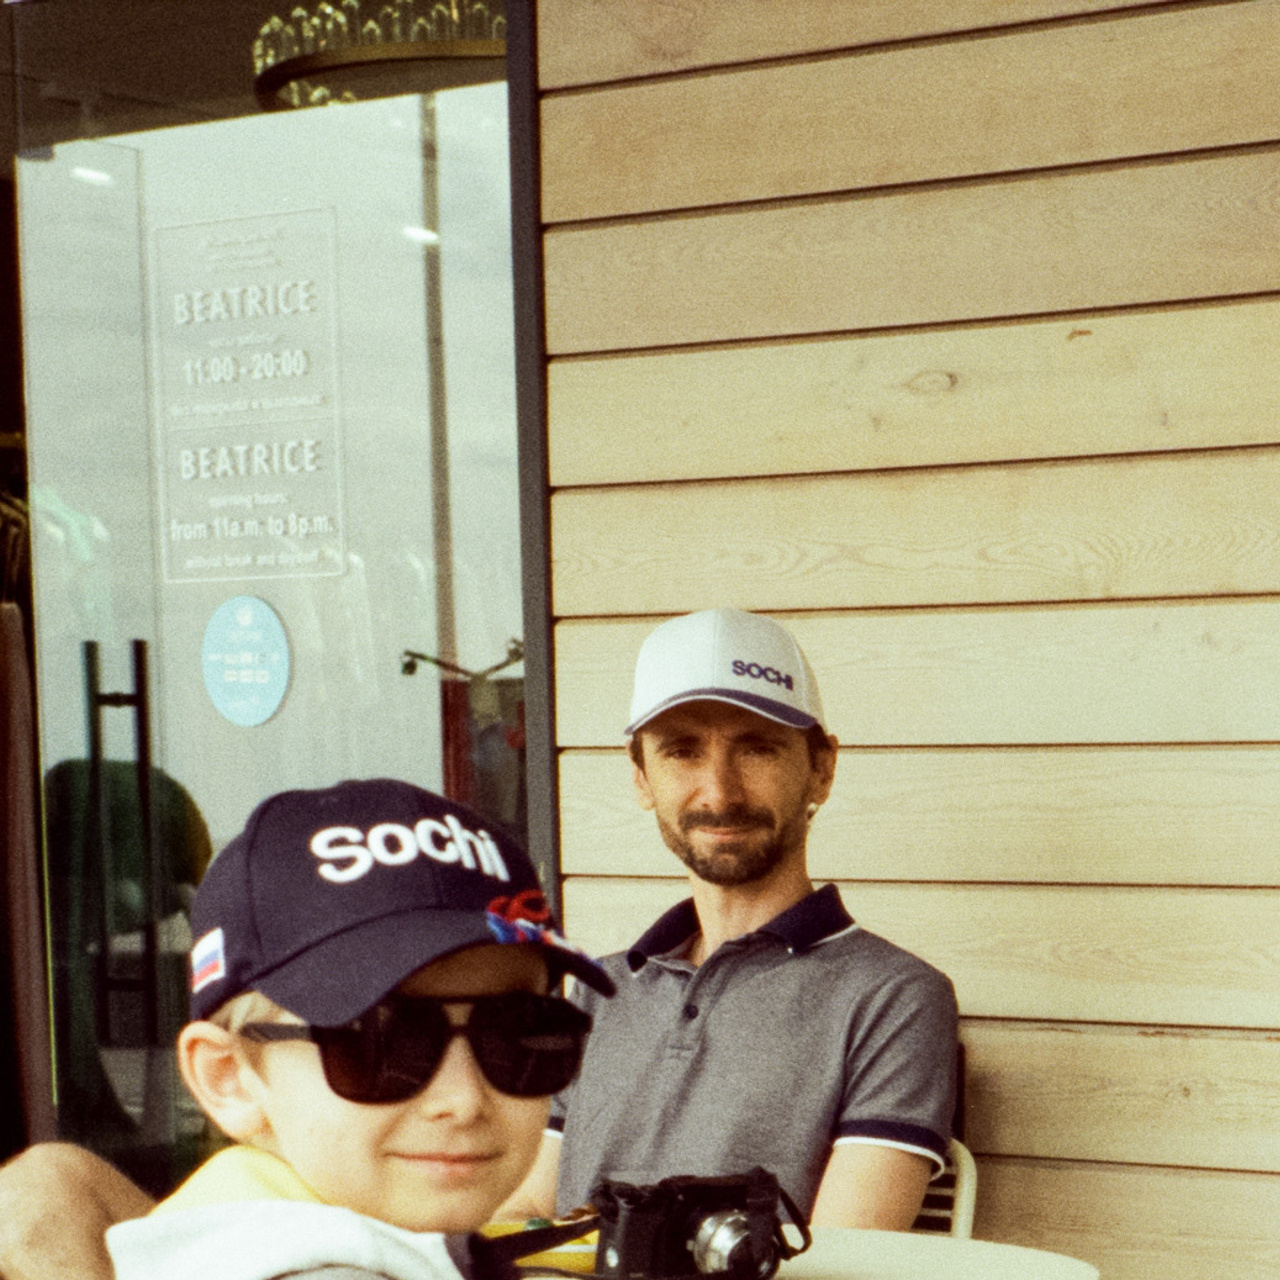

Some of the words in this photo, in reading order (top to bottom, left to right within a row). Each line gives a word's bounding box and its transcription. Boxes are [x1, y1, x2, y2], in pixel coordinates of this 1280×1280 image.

[175, 280, 316, 325] BEATRICE
[181, 440, 320, 480] BEATRICE
[732, 659, 794, 690] SOCHI
